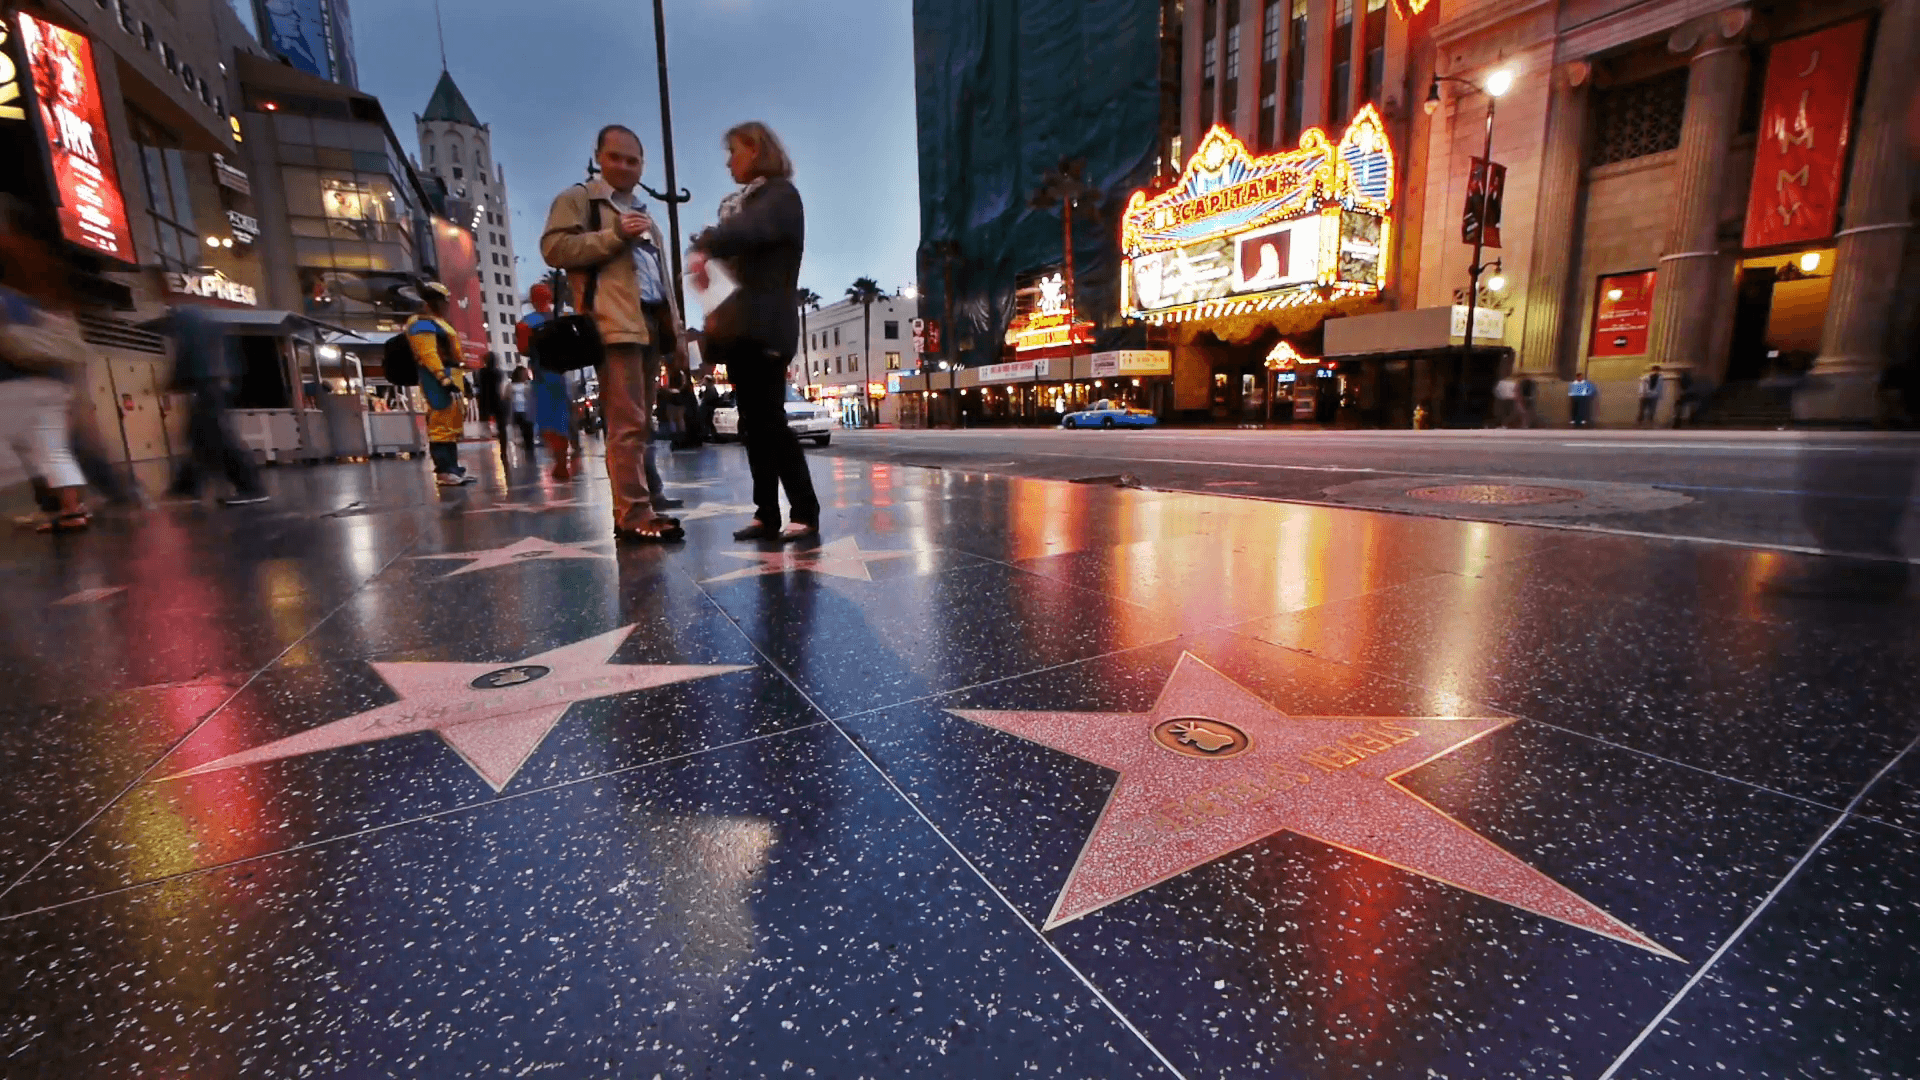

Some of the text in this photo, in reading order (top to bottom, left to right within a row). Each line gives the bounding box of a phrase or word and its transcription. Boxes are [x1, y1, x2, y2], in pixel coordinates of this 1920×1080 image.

[1777, 50, 1820, 226] JIMMY
[1180, 172, 1282, 220] CAPITAN
[164, 271, 257, 306] EXPRESS
[1300, 721, 1420, 774] STEVEN
